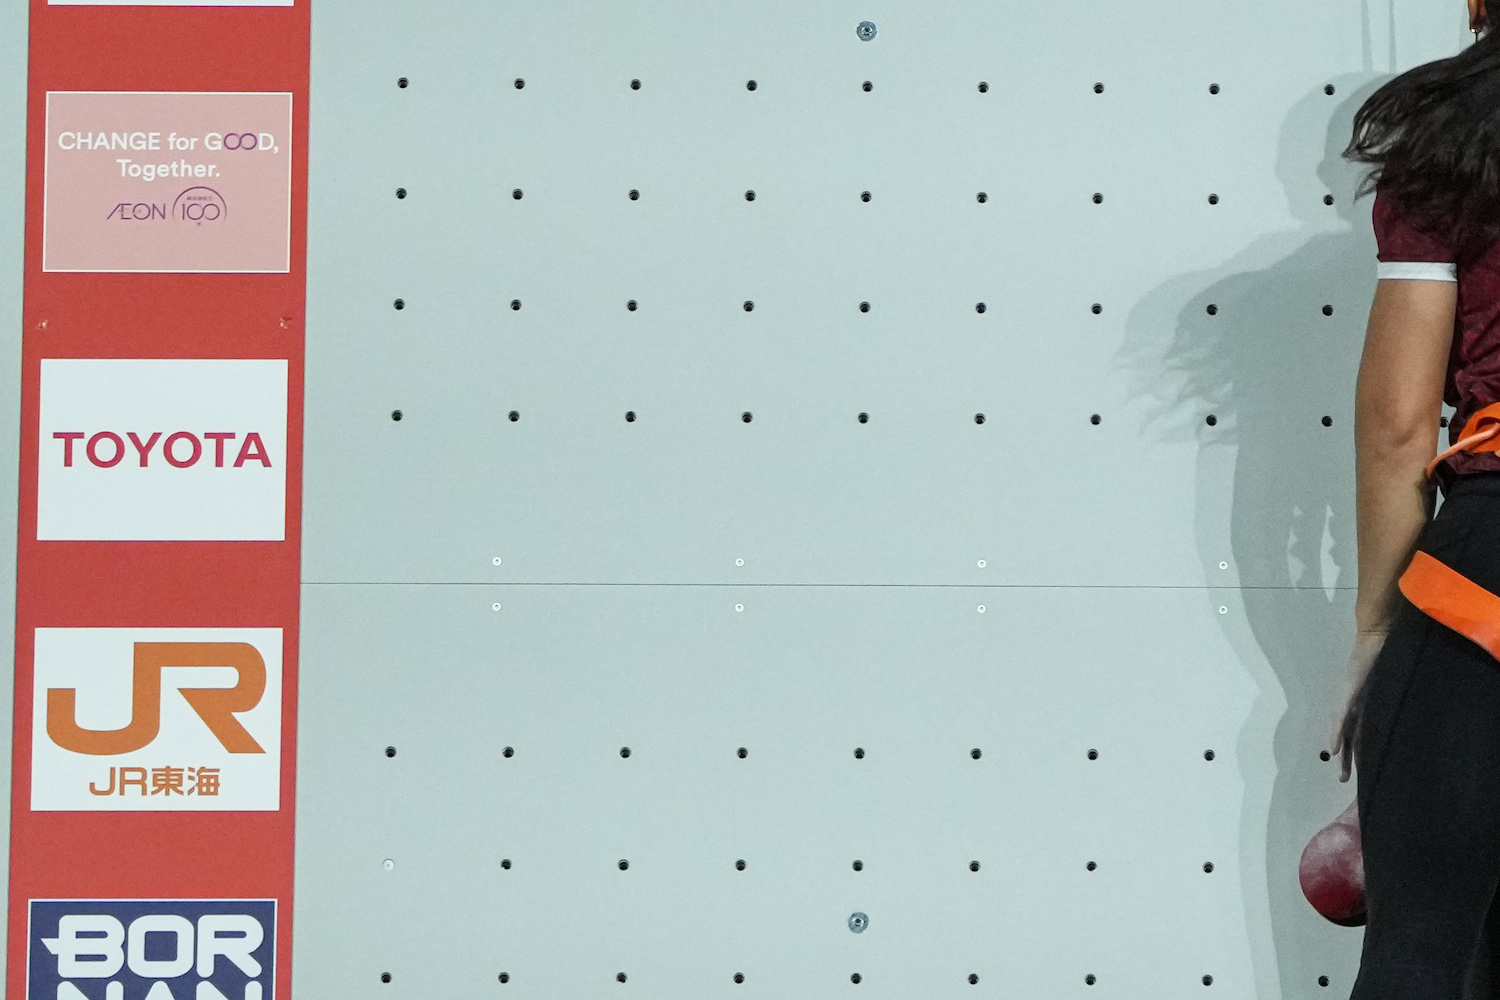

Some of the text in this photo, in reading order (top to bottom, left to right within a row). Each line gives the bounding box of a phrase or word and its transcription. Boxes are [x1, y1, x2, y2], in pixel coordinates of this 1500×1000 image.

[58, 132, 279, 154] CHANGE for GOOD,
[116, 158, 221, 182] Together.
[52, 431, 273, 469] TOYOTA
[46, 642, 267, 756] JR
[89, 766, 221, 797] JR東海
[40, 914, 264, 978] BOR
